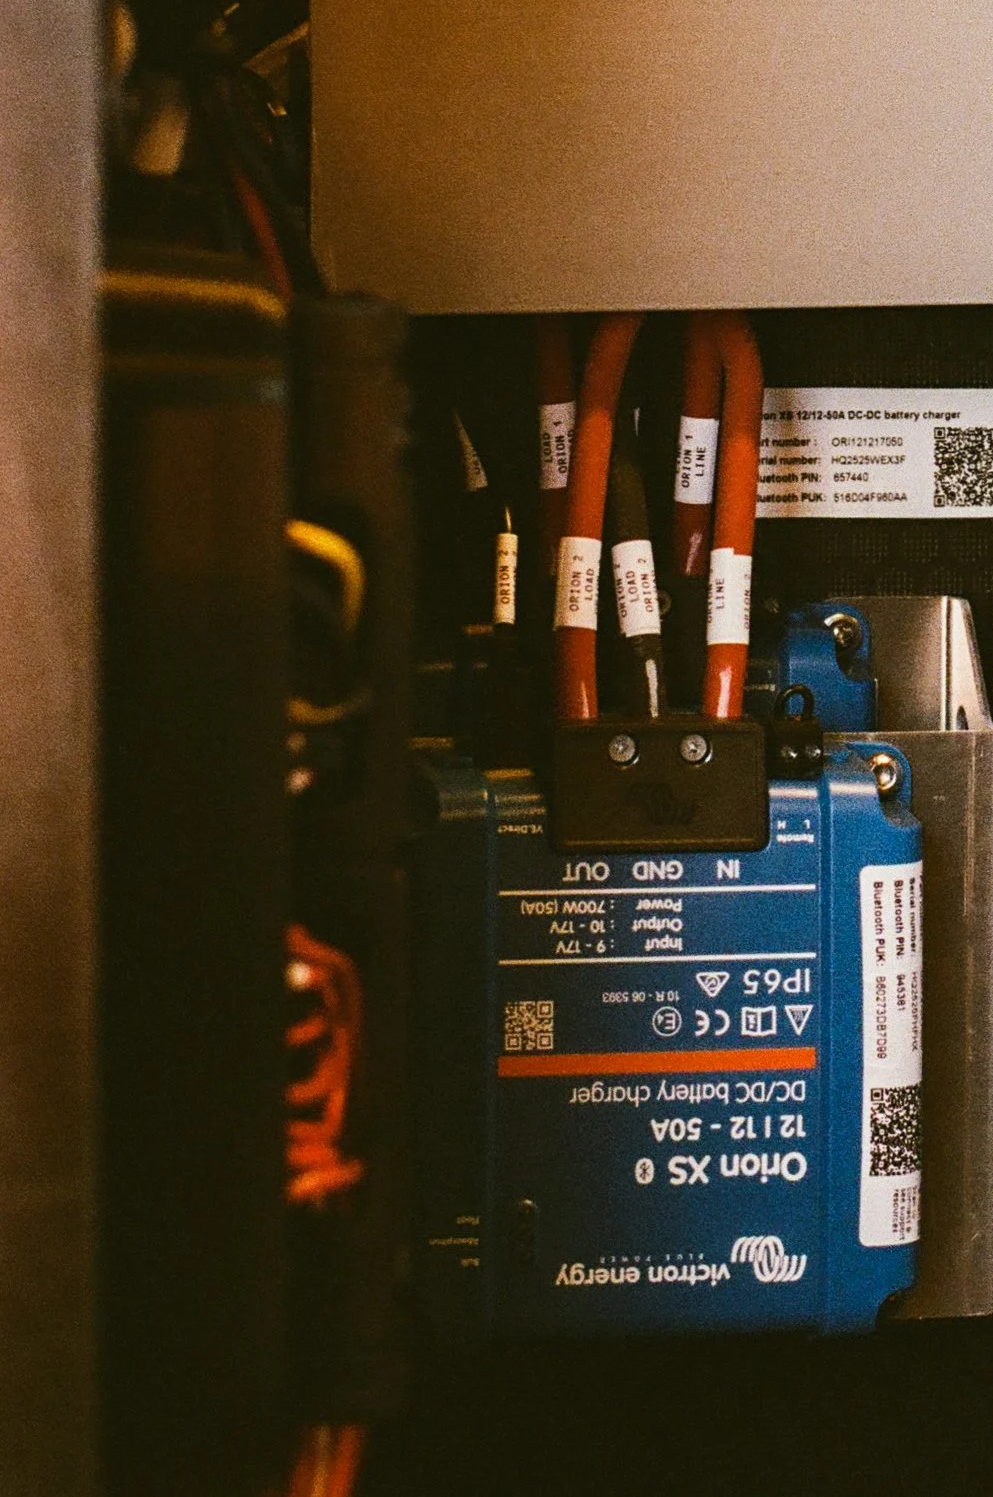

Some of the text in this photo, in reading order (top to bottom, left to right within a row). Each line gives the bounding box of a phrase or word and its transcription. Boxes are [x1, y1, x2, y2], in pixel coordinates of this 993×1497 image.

[797, 410, 845, 421] 12/12-50A
[848, 410, 882, 421] DC-DC
[884, 410, 920, 422] battery
[922, 410, 961, 421] charger
[542, 433, 553, 464] LOAD
[555, 434, 568, 474] ORION
[695, 446, 706, 477] LINE
[681, 449, 693, 489] ORION
[500, 565, 511, 605] ORION
[568, 571, 583, 612] ORION
[584, 568, 595, 601] LOAD
[625, 570, 639, 604] LOAD
[640, 572, 654, 614] ORION
[714, 578, 726, 610] LINE
[496, 822, 543, 835] VE.Direct
[562, 859, 740, 883] IN GND OUT
[520, 898, 683, 917] Power 700W (50A)
[894, 879, 904, 934] Bluetooth
[549, 917, 683, 935] Output 10 17V
[873, 881, 886, 967] Bluetooth PUK:
[555, 939, 581, 955] 17V
[645, 936, 683, 953] Input
[742, 968, 811, 995] IP65
[568, 1079, 807, 1108] DC/DC battery charger
[650, 1114, 807, 1143] 12 12 50A
[667, 1152, 809, 1186] Orion XS
[554, 1262, 731, 1288] victron energy
